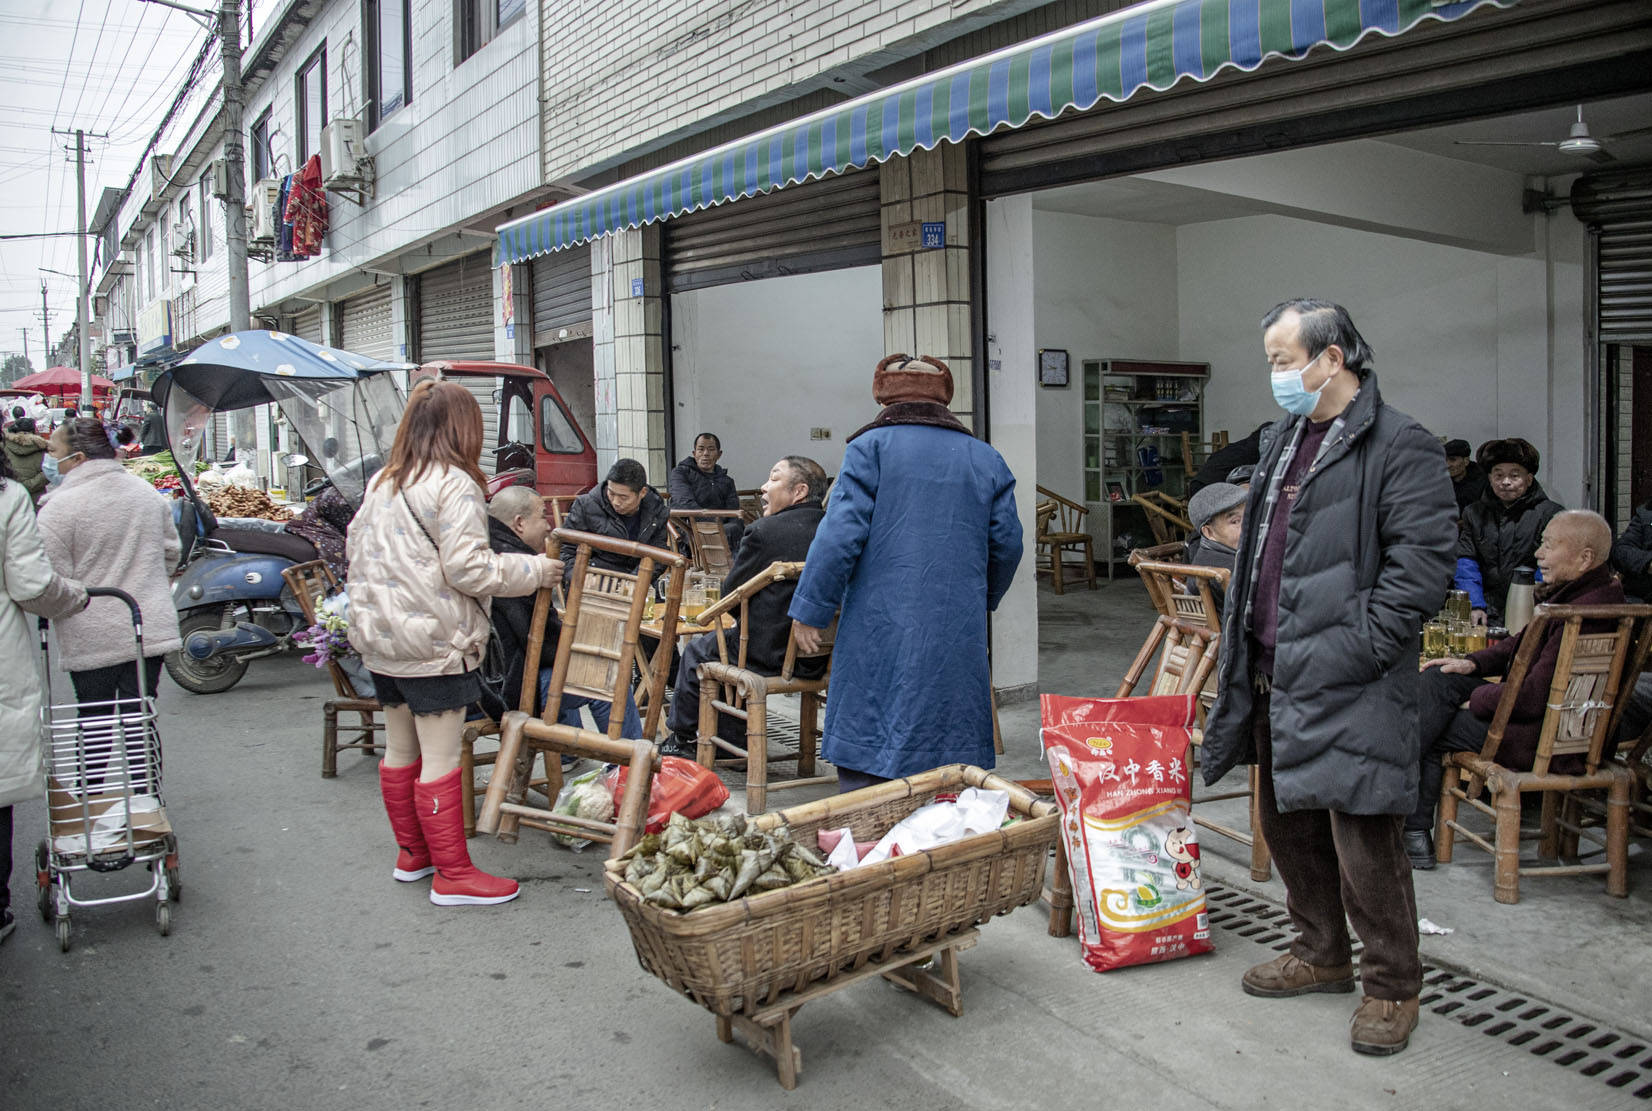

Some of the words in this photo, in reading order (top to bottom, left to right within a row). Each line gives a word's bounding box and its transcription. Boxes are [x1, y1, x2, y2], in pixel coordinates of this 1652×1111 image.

[1098, 757, 1185, 785] 汉中香米
[1106, 790, 1124, 798] HAN
[1126, 787, 1154, 797] ZHONG
